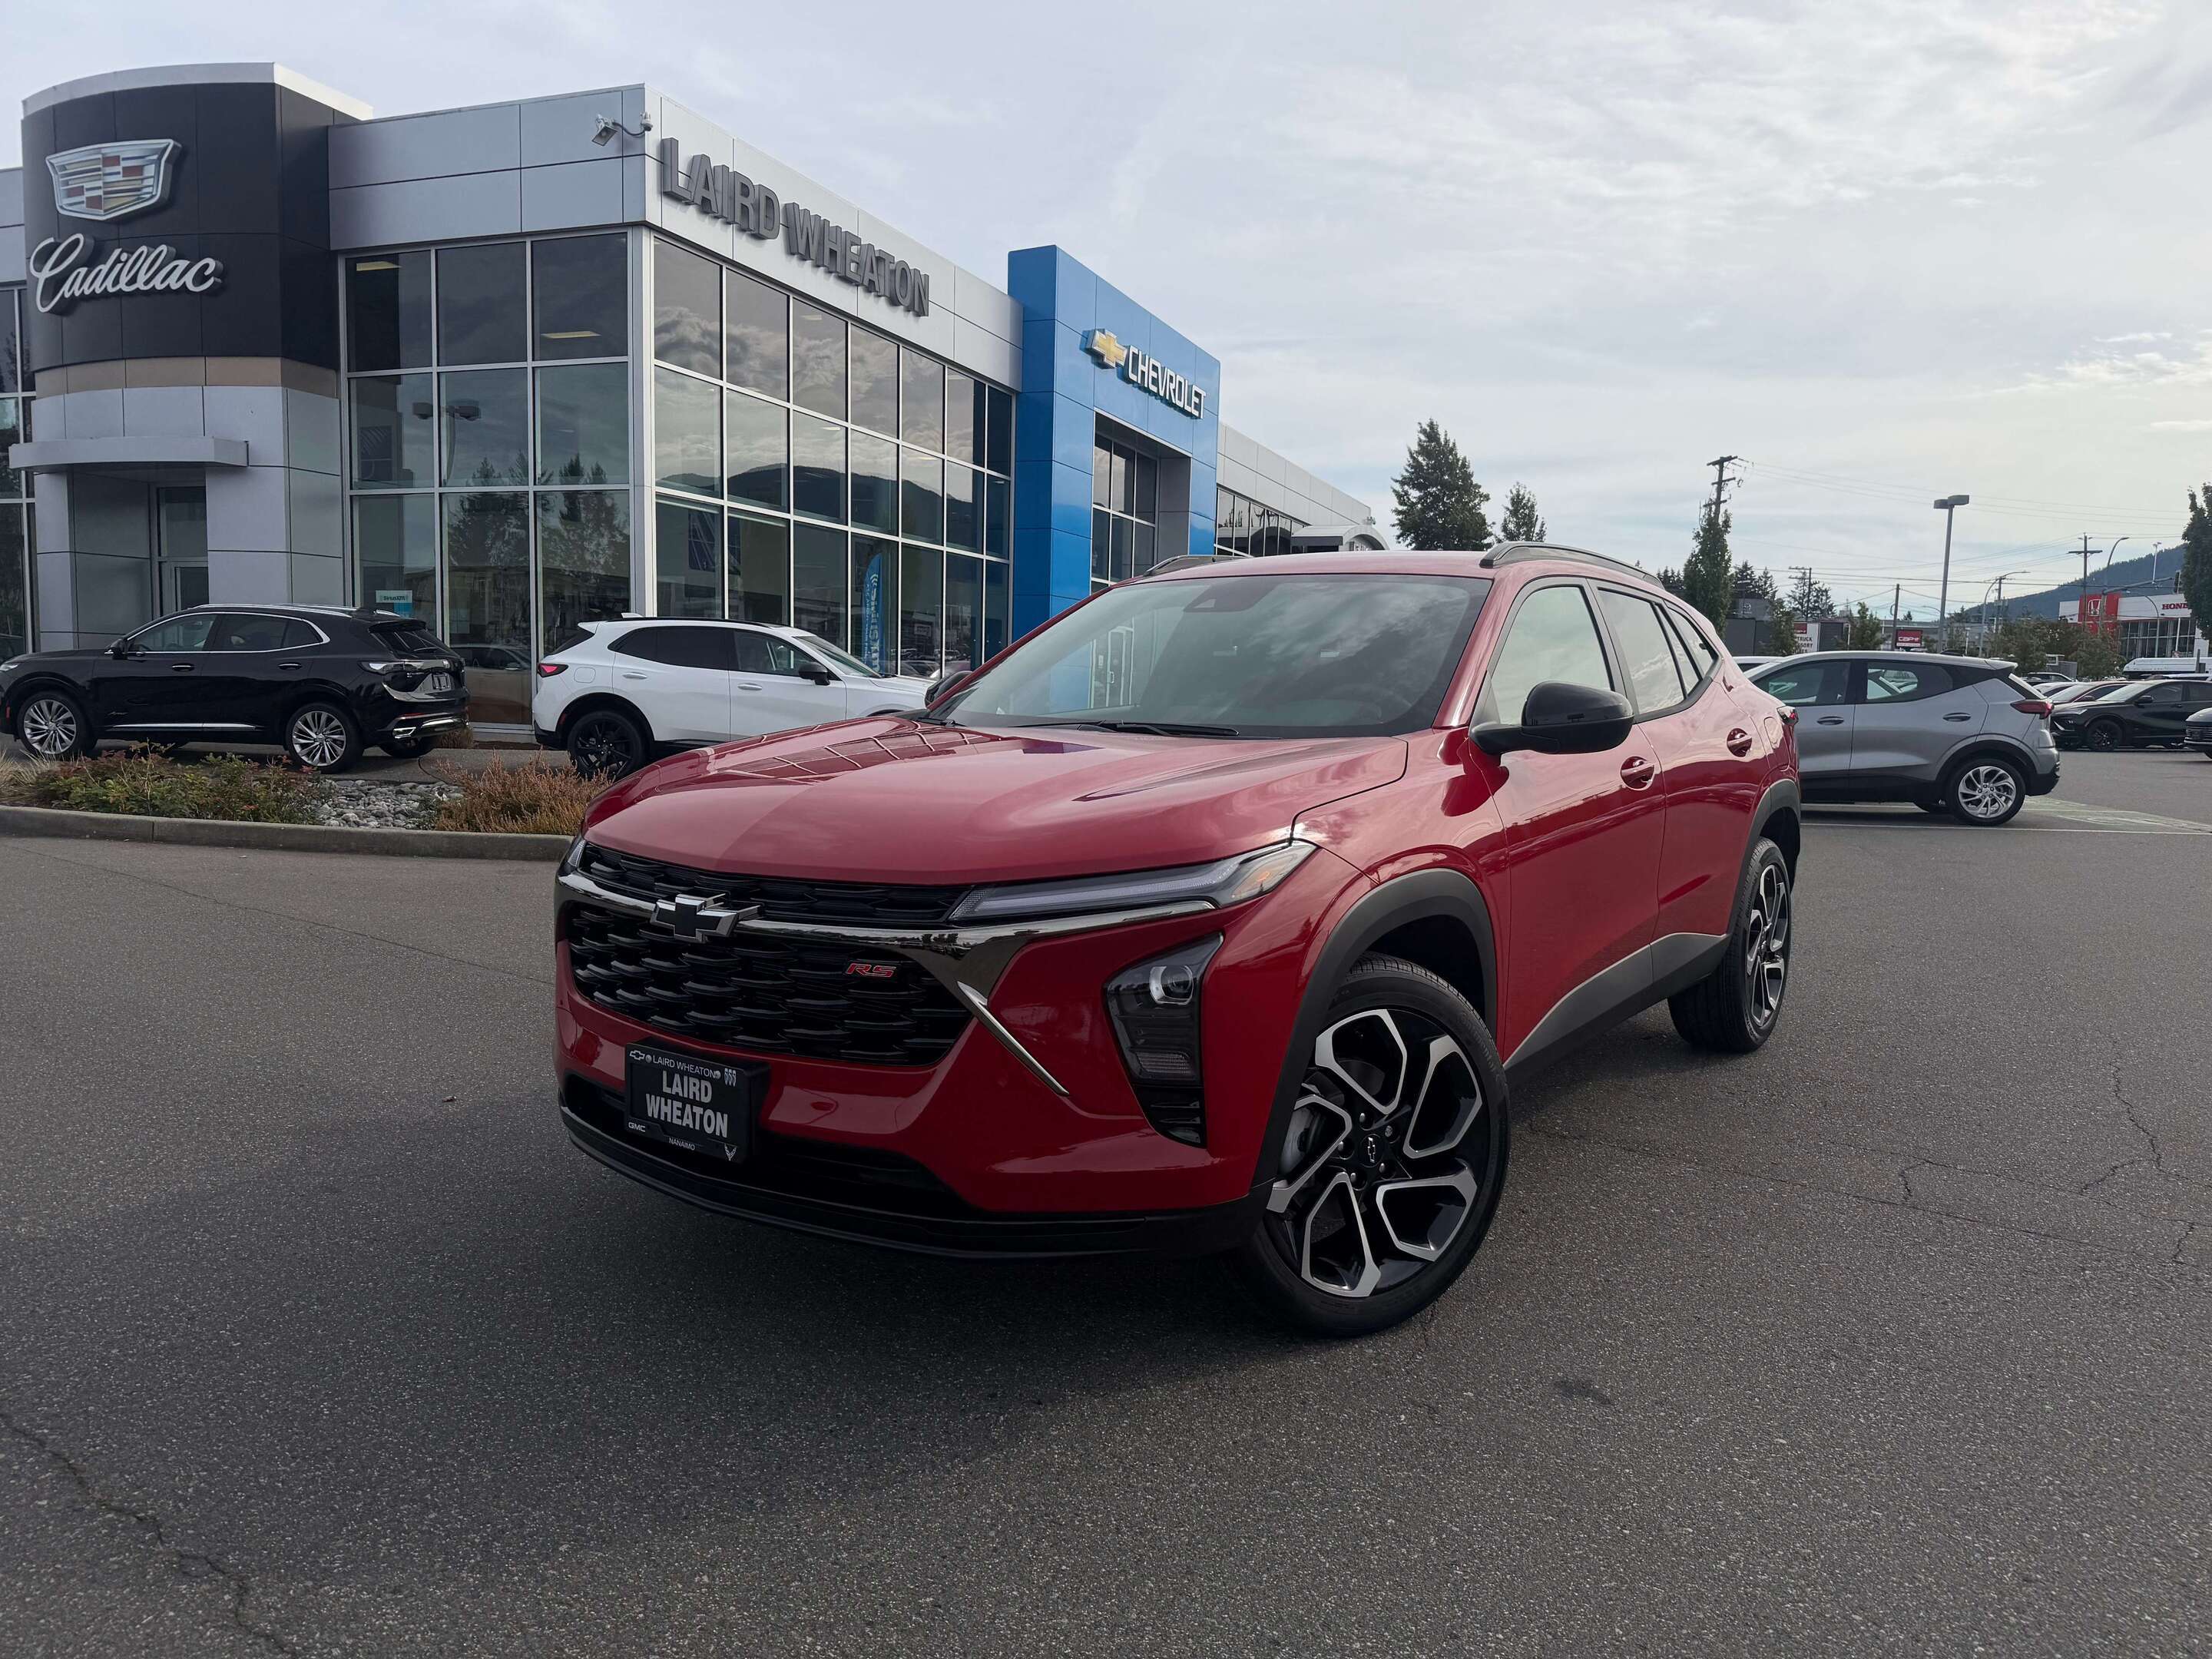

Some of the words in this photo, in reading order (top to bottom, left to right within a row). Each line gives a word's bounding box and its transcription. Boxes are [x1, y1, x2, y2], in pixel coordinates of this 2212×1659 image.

[661, 137, 780, 240] LAIRD
[784, 202, 930, 317] WHEATON
[30, 233, 218, 313] Cadillac
[1128, 345, 1207, 419] CHEVROLET
[846, 962, 897, 978] RS
[653, 1055, 675, 1068] LAIRD
[677, 1061, 716, 1079] WHEATON
[662, 1070, 713, 1104] LAIRD
[628, 1121, 646, 1132] GMC
[645, 1093, 728, 1138] WHEATON
[669, 1137, 695, 1151] NANAIMO
